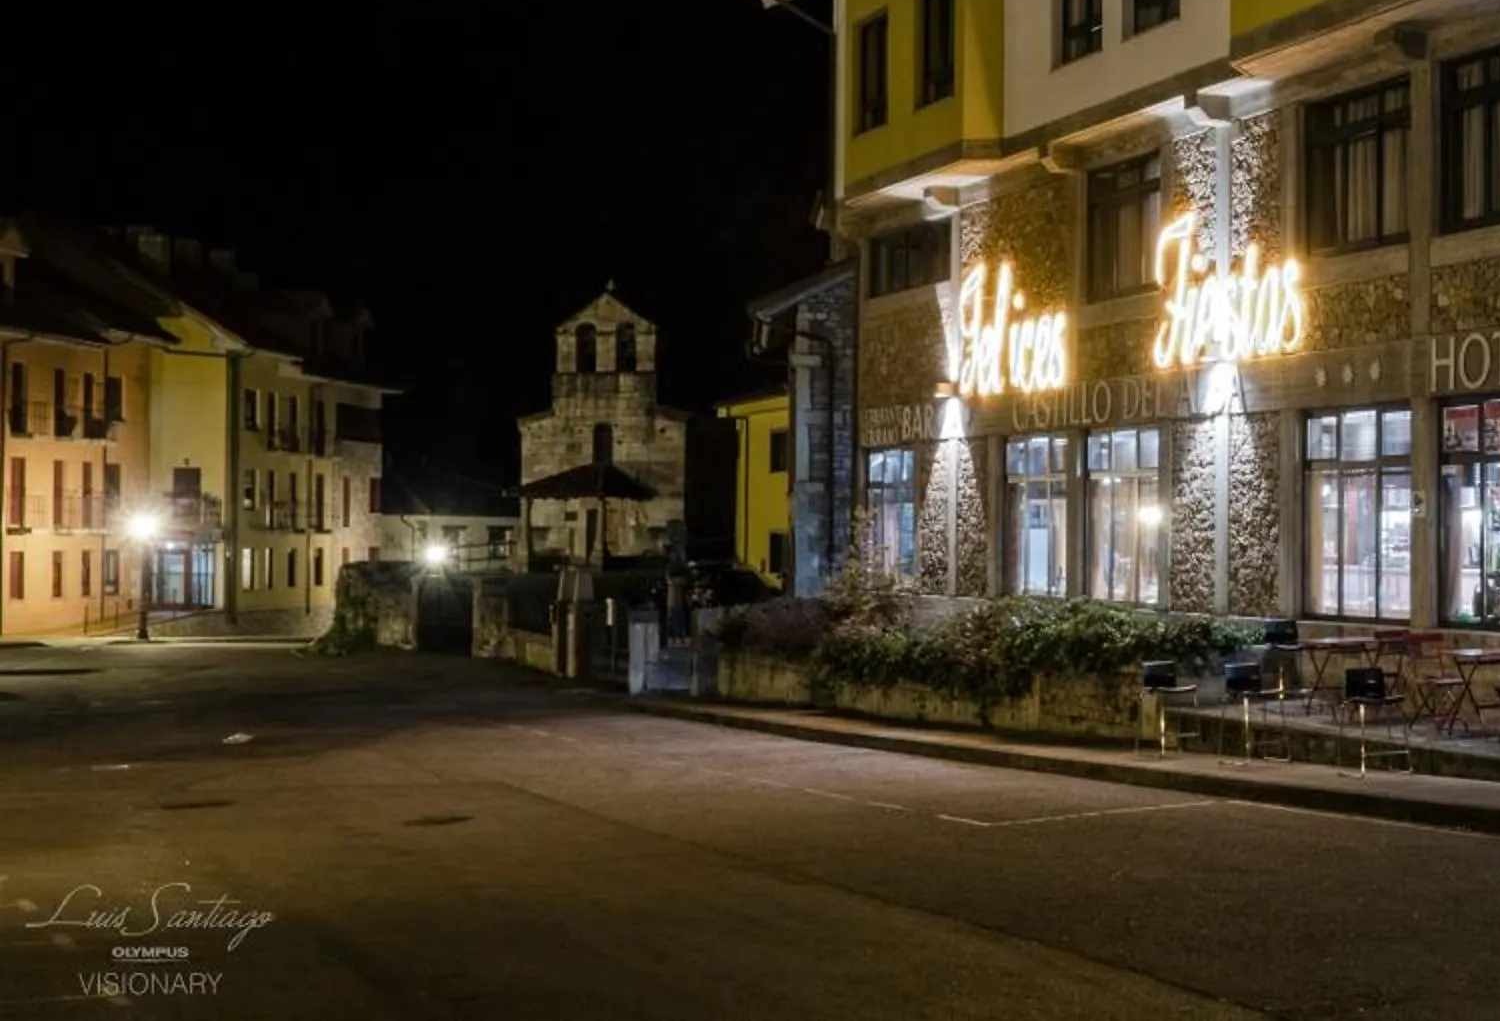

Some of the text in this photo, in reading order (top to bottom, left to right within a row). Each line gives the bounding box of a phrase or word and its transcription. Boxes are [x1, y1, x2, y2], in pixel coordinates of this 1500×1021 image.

[1154, 211, 1302, 368] Fiestas
[902, 403, 937, 441] BAR
[1012, 378, 1112, 431] CASTILLO
[1123, 375, 1170, 420] DEL
